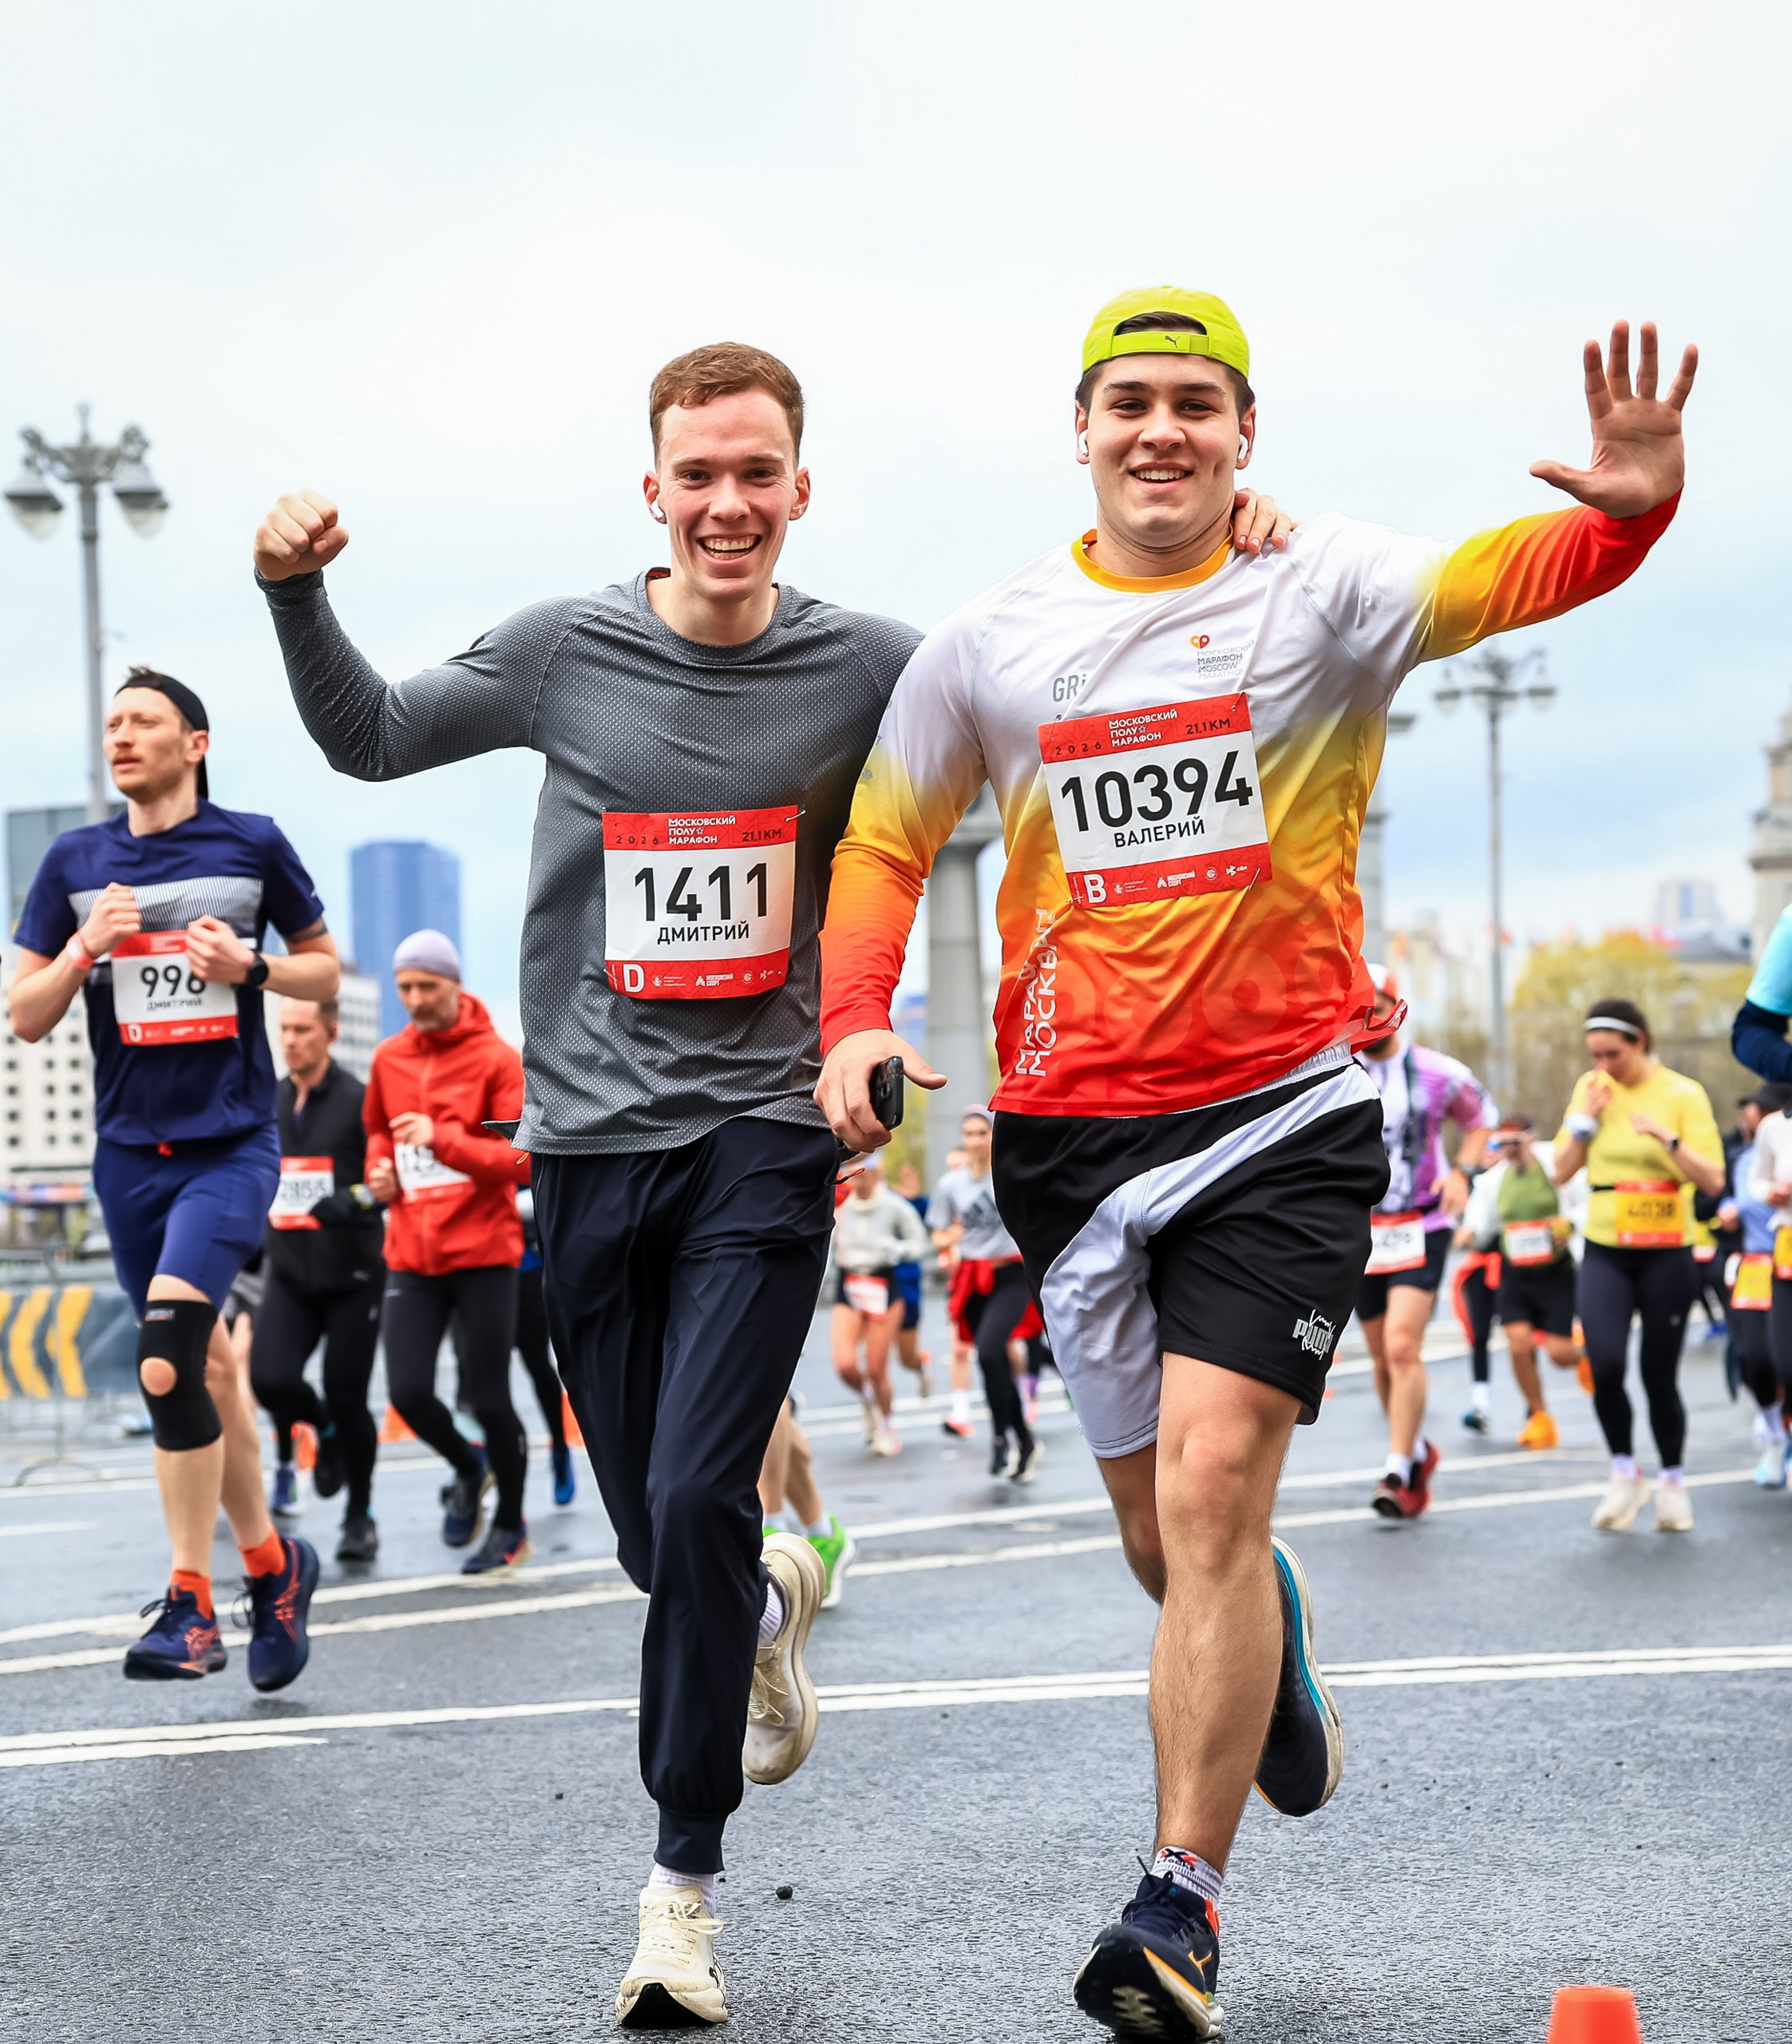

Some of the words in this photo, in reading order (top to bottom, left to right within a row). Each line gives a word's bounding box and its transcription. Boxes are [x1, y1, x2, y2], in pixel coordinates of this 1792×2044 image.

[1197, 653, 1243, 665] МАРАФОН
[1198, 662, 1238, 673] MOSCOW
[1109, 708, 1178, 729] МОСКОВСКИЙ
[1110, 726, 1138, 739] ПОЛУ
[1112, 732, 1162, 747] МАРАФОН
[1055, 741, 1102, 756] 2026
[1061, 750, 1253, 832] 10394
[668, 815, 736, 827] МОСКОВСКИЙ
[669, 827, 696, 836] ПОЛУ
[1114, 816, 1205, 848] ВАЛЕРИЙ
[615, 835, 659, 845] 2026
[669, 835, 718, 845] МАРАФОН
[635, 862, 767, 922] 1411
[1083, 873, 1107, 904] B
[657, 920, 750, 945] ДМИТРИЙ
[140, 965, 206, 998] 996
[623, 963, 645, 993] D
